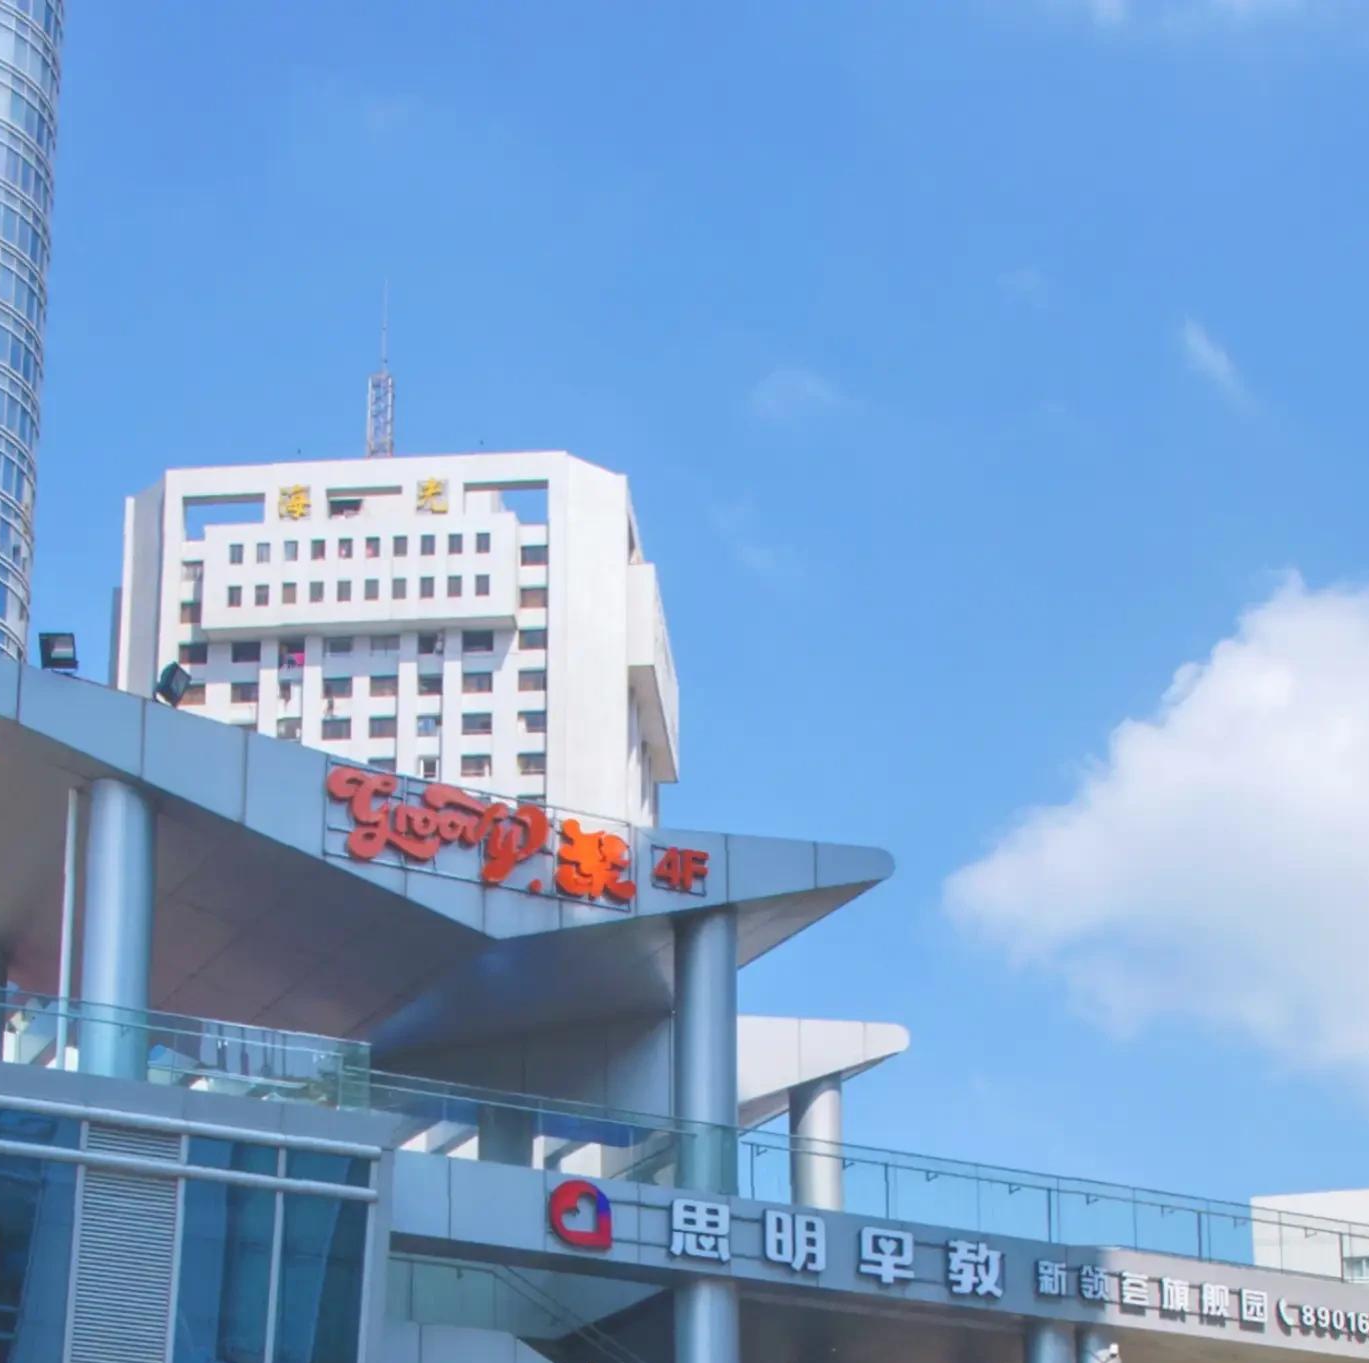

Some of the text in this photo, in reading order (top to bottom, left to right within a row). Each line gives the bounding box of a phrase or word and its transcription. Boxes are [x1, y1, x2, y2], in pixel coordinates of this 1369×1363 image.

[654, 846, 710, 892] 4F
[670, 1198, 1006, 1300] 思明早教
[1035, 1259, 1268, 1324] 新领荟旗舰园
